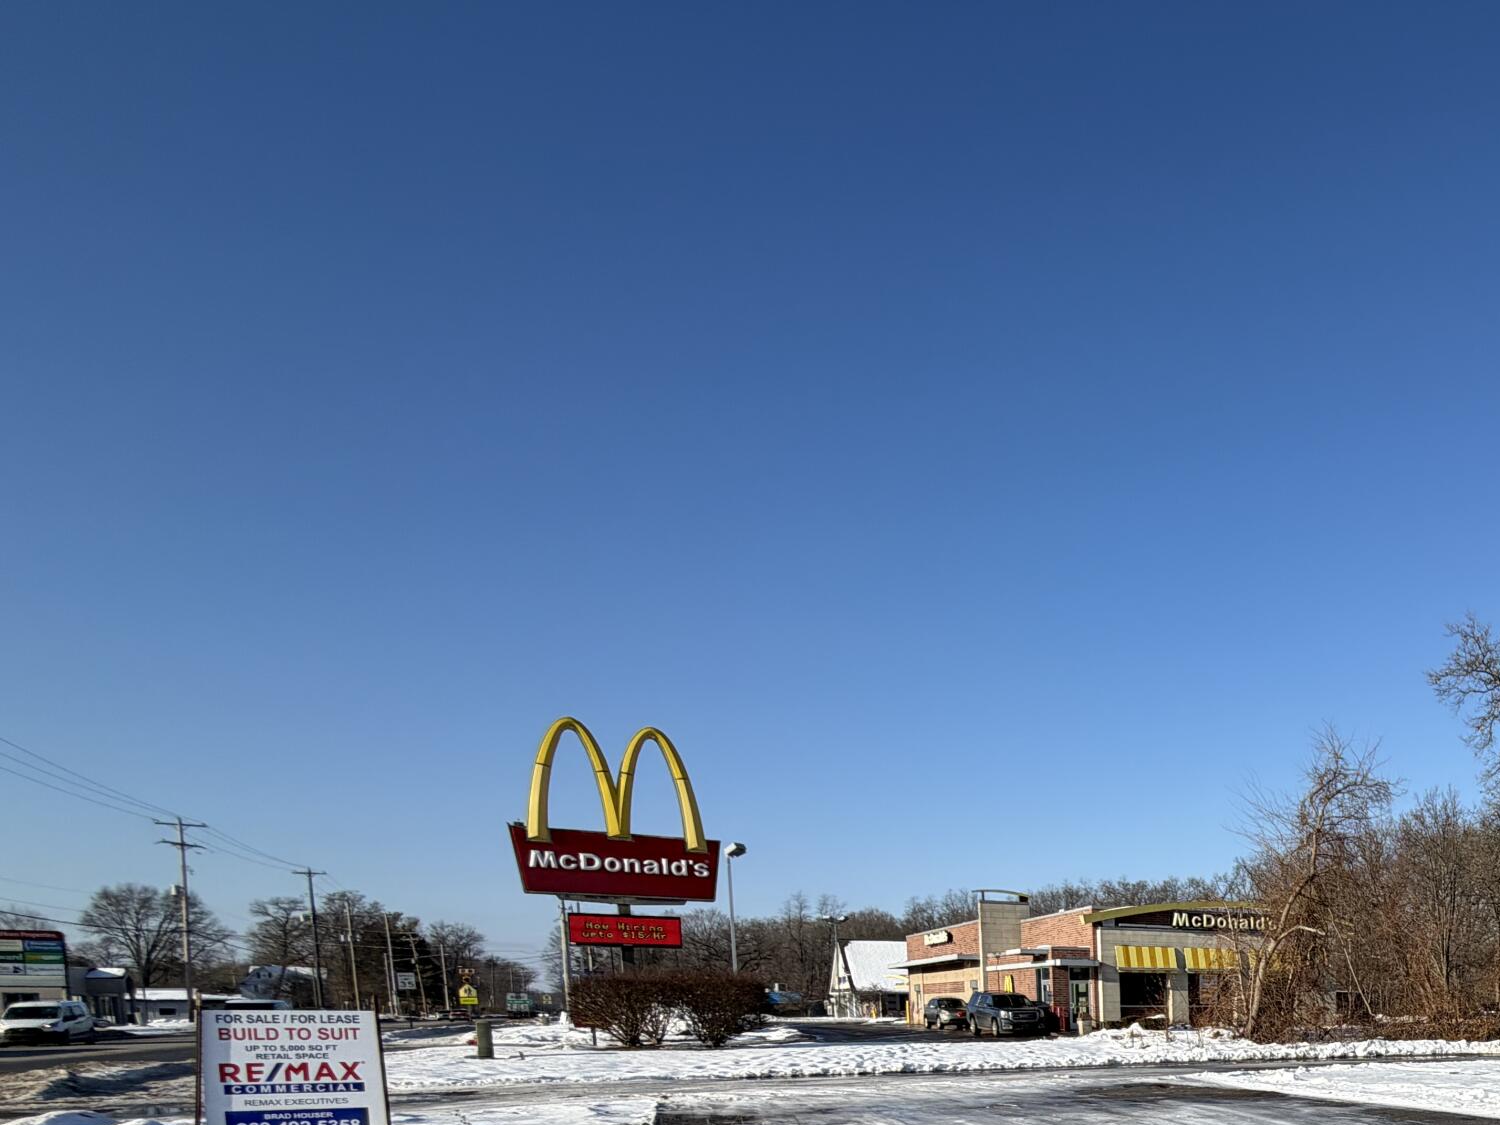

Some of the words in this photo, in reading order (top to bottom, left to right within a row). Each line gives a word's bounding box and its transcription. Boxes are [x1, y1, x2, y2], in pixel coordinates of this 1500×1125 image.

[528, 849, 710, 877] McDonald's
[215, 1014, 243, 1024] FOR
[246, 1014, 280, 1024] SALE
[290, 1014, 317, 1024] FOR
[320, 1014, 360, 1024] LEASE
[218, 1027, 280, 1041] BUILD
[284, 1027, 312, 1041] TO
[317, 1027, 361, 1041] SUIT
[218, 1061, 362, 1083] RE/MAX
[231, 1083, 358, 1094] COMMERCIAL
[244, 1099, 282, 1107] REMAX
[284, 1097, 349, 1106] EXECUTIVES
[293, 1111, 334, 1119] HOUSER
